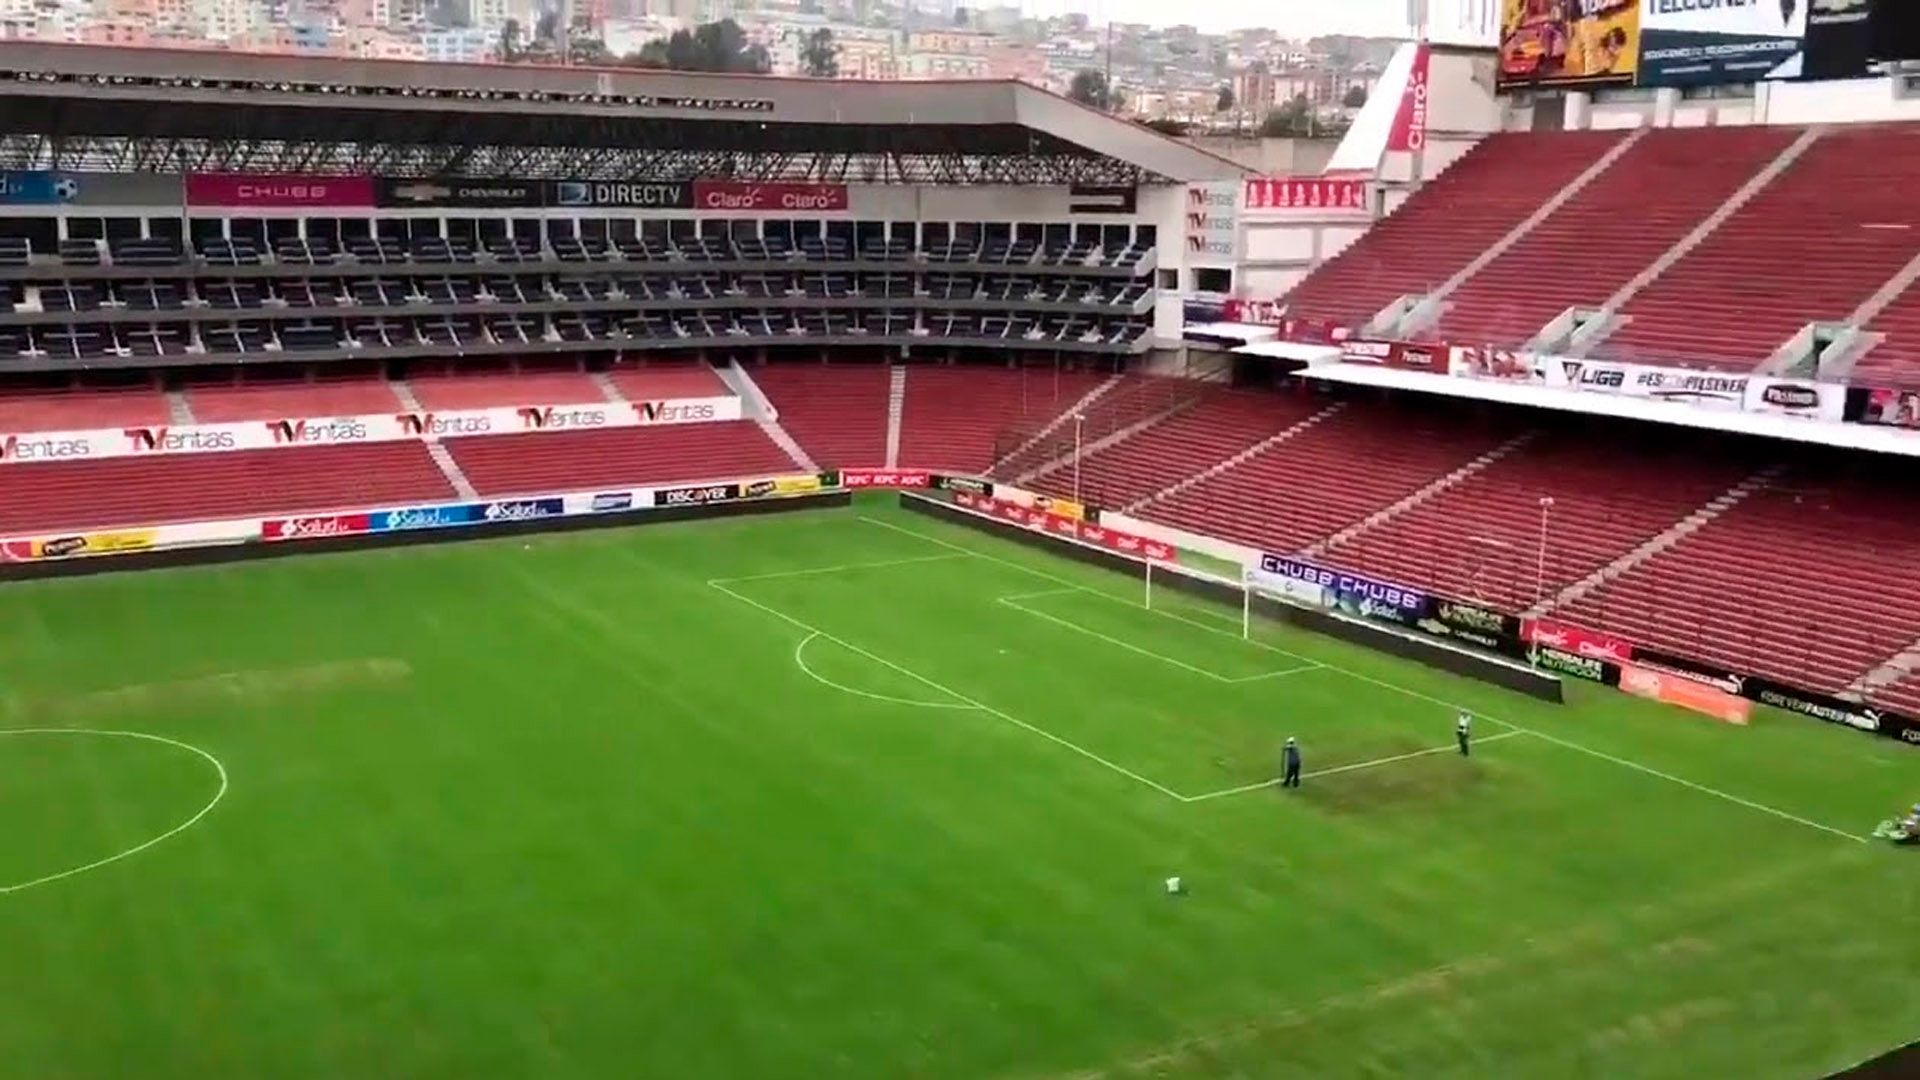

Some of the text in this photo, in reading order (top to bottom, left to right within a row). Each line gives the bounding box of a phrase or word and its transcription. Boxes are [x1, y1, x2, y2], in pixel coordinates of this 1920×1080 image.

[1650, 0, 1757, 14] TELCO
[1408, 84, 1425, 149] Claro
[238, 185, 327, 198] CHUBB
[596, 184, 681, 204] DIRECTV
[706, 190, 830, 208] Claro Claro
[516, 407, 605, 428] TVentas
[632, 401, 714, 421] TVentas
[265, 420, 367, 443] TVentas
[396, 413, 491, 434] TVentas
[124, 428, 235, 450] TVentas
[666, 487, 727, 503] DISCOVER
[1263, 557, 1418, 609] CHUBB CHUBB
